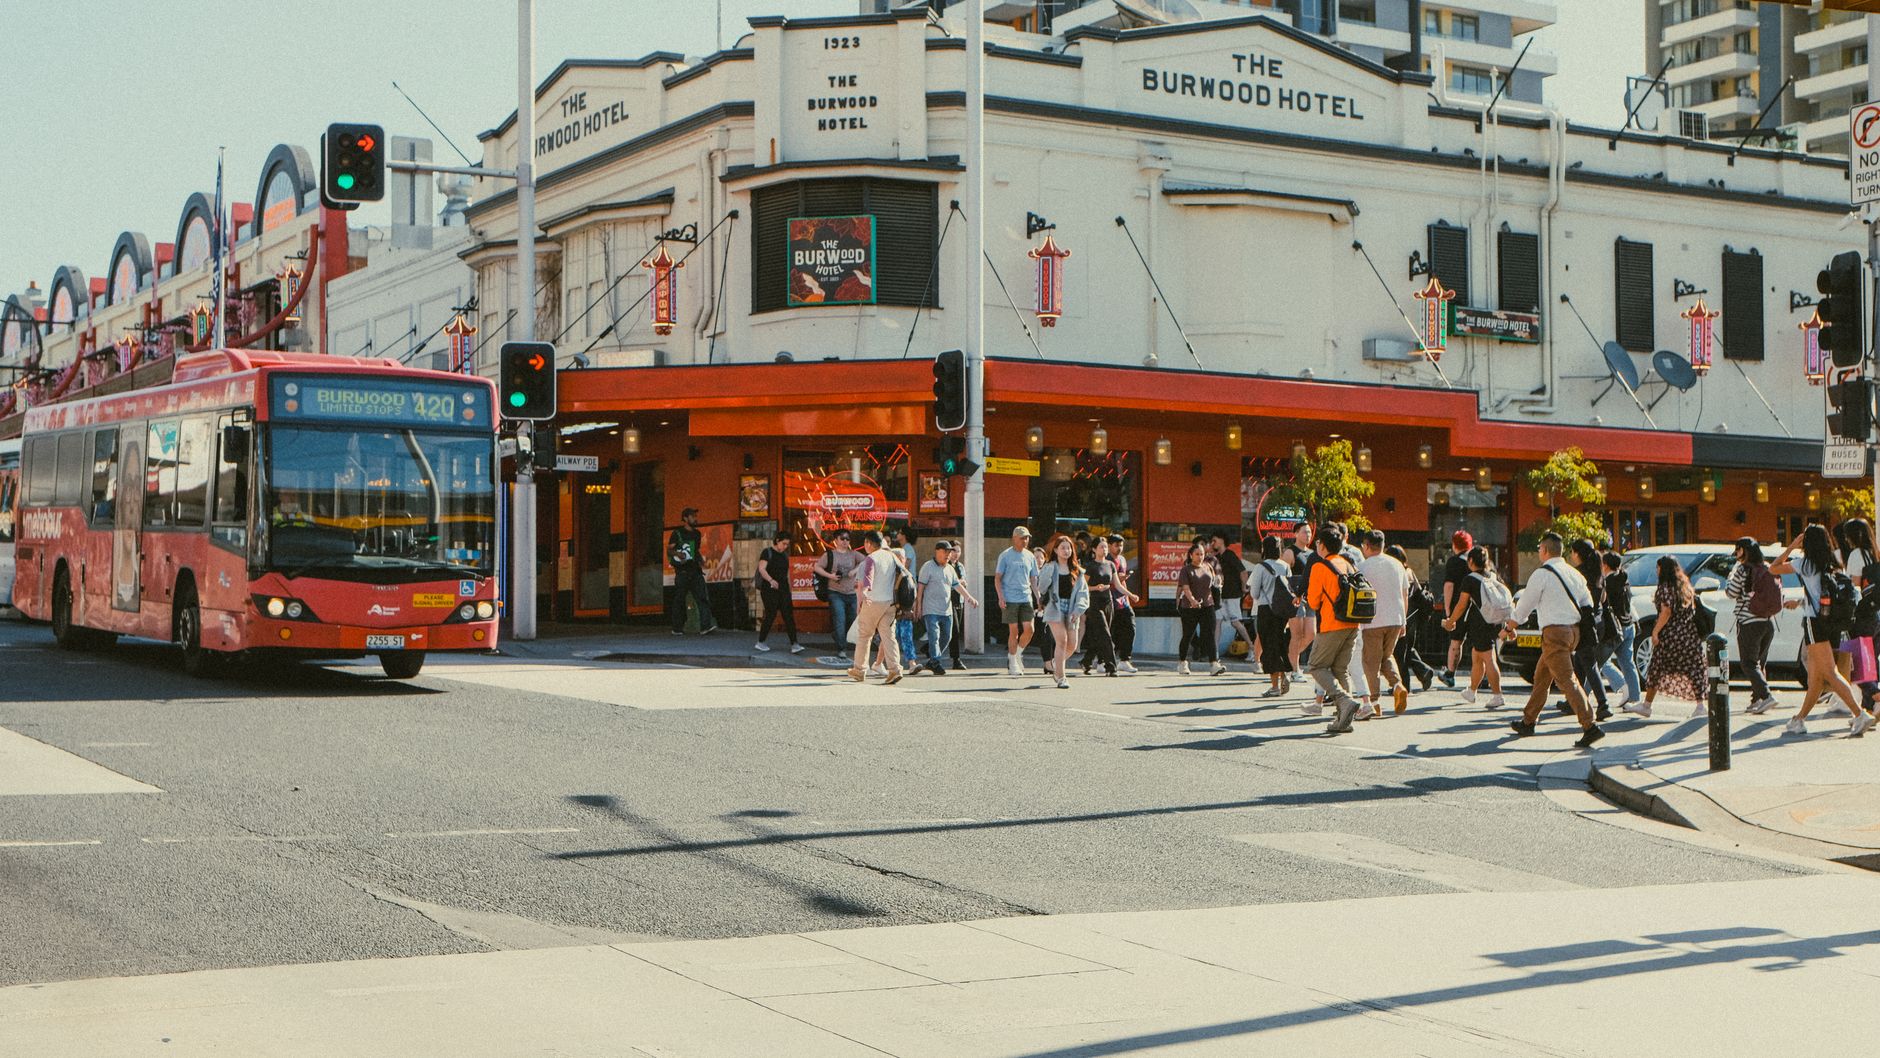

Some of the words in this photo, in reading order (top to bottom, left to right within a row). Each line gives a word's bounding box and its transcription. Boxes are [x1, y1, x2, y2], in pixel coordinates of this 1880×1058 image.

[824, 36, 860, 49] 1923
[1232, 53, 1283, 78] THE
[828, 75, 857, 88] THE
[1143, 68, 1271, 106] BURWOOD
[1278, 88, 1364, 120] HOTEL
[561, 92, 587, 118] THE
[808, 96, 877, 110] BURWOOD
[535, 121, 580, 158] RWOOD
[584, 101, 629, 137] HOTEL
[818, 117, 868, 131] HOTEL
[1860, 151, 1879, 168] NO
[821, 240, 839, 250] THE
[794, 248, 865, 266] BURWOOD
[816, 265, 844, 276] HOTEL
[1509, 321, 1531, 332] HOTEL
[317, 389, 405, 406] BURWOOD
[414, 395, 454, 417] 420
[320, 402, 362, 413] LIMITED
[366, 404, 401, 416] STOPS
[1832, 450, 1858, 458] BUSES
[558, 457, 580, 465] AILWAY
[583, 458, 597, 466] PDE
[1826, 462, 1862, 471] EXCEPTED
[1152, 571, 1170, 580] 20%
[793, 578, 814, 587] 20%
[368, 634, 389, 646] 2255
[393, 634, 403, 646] ST
